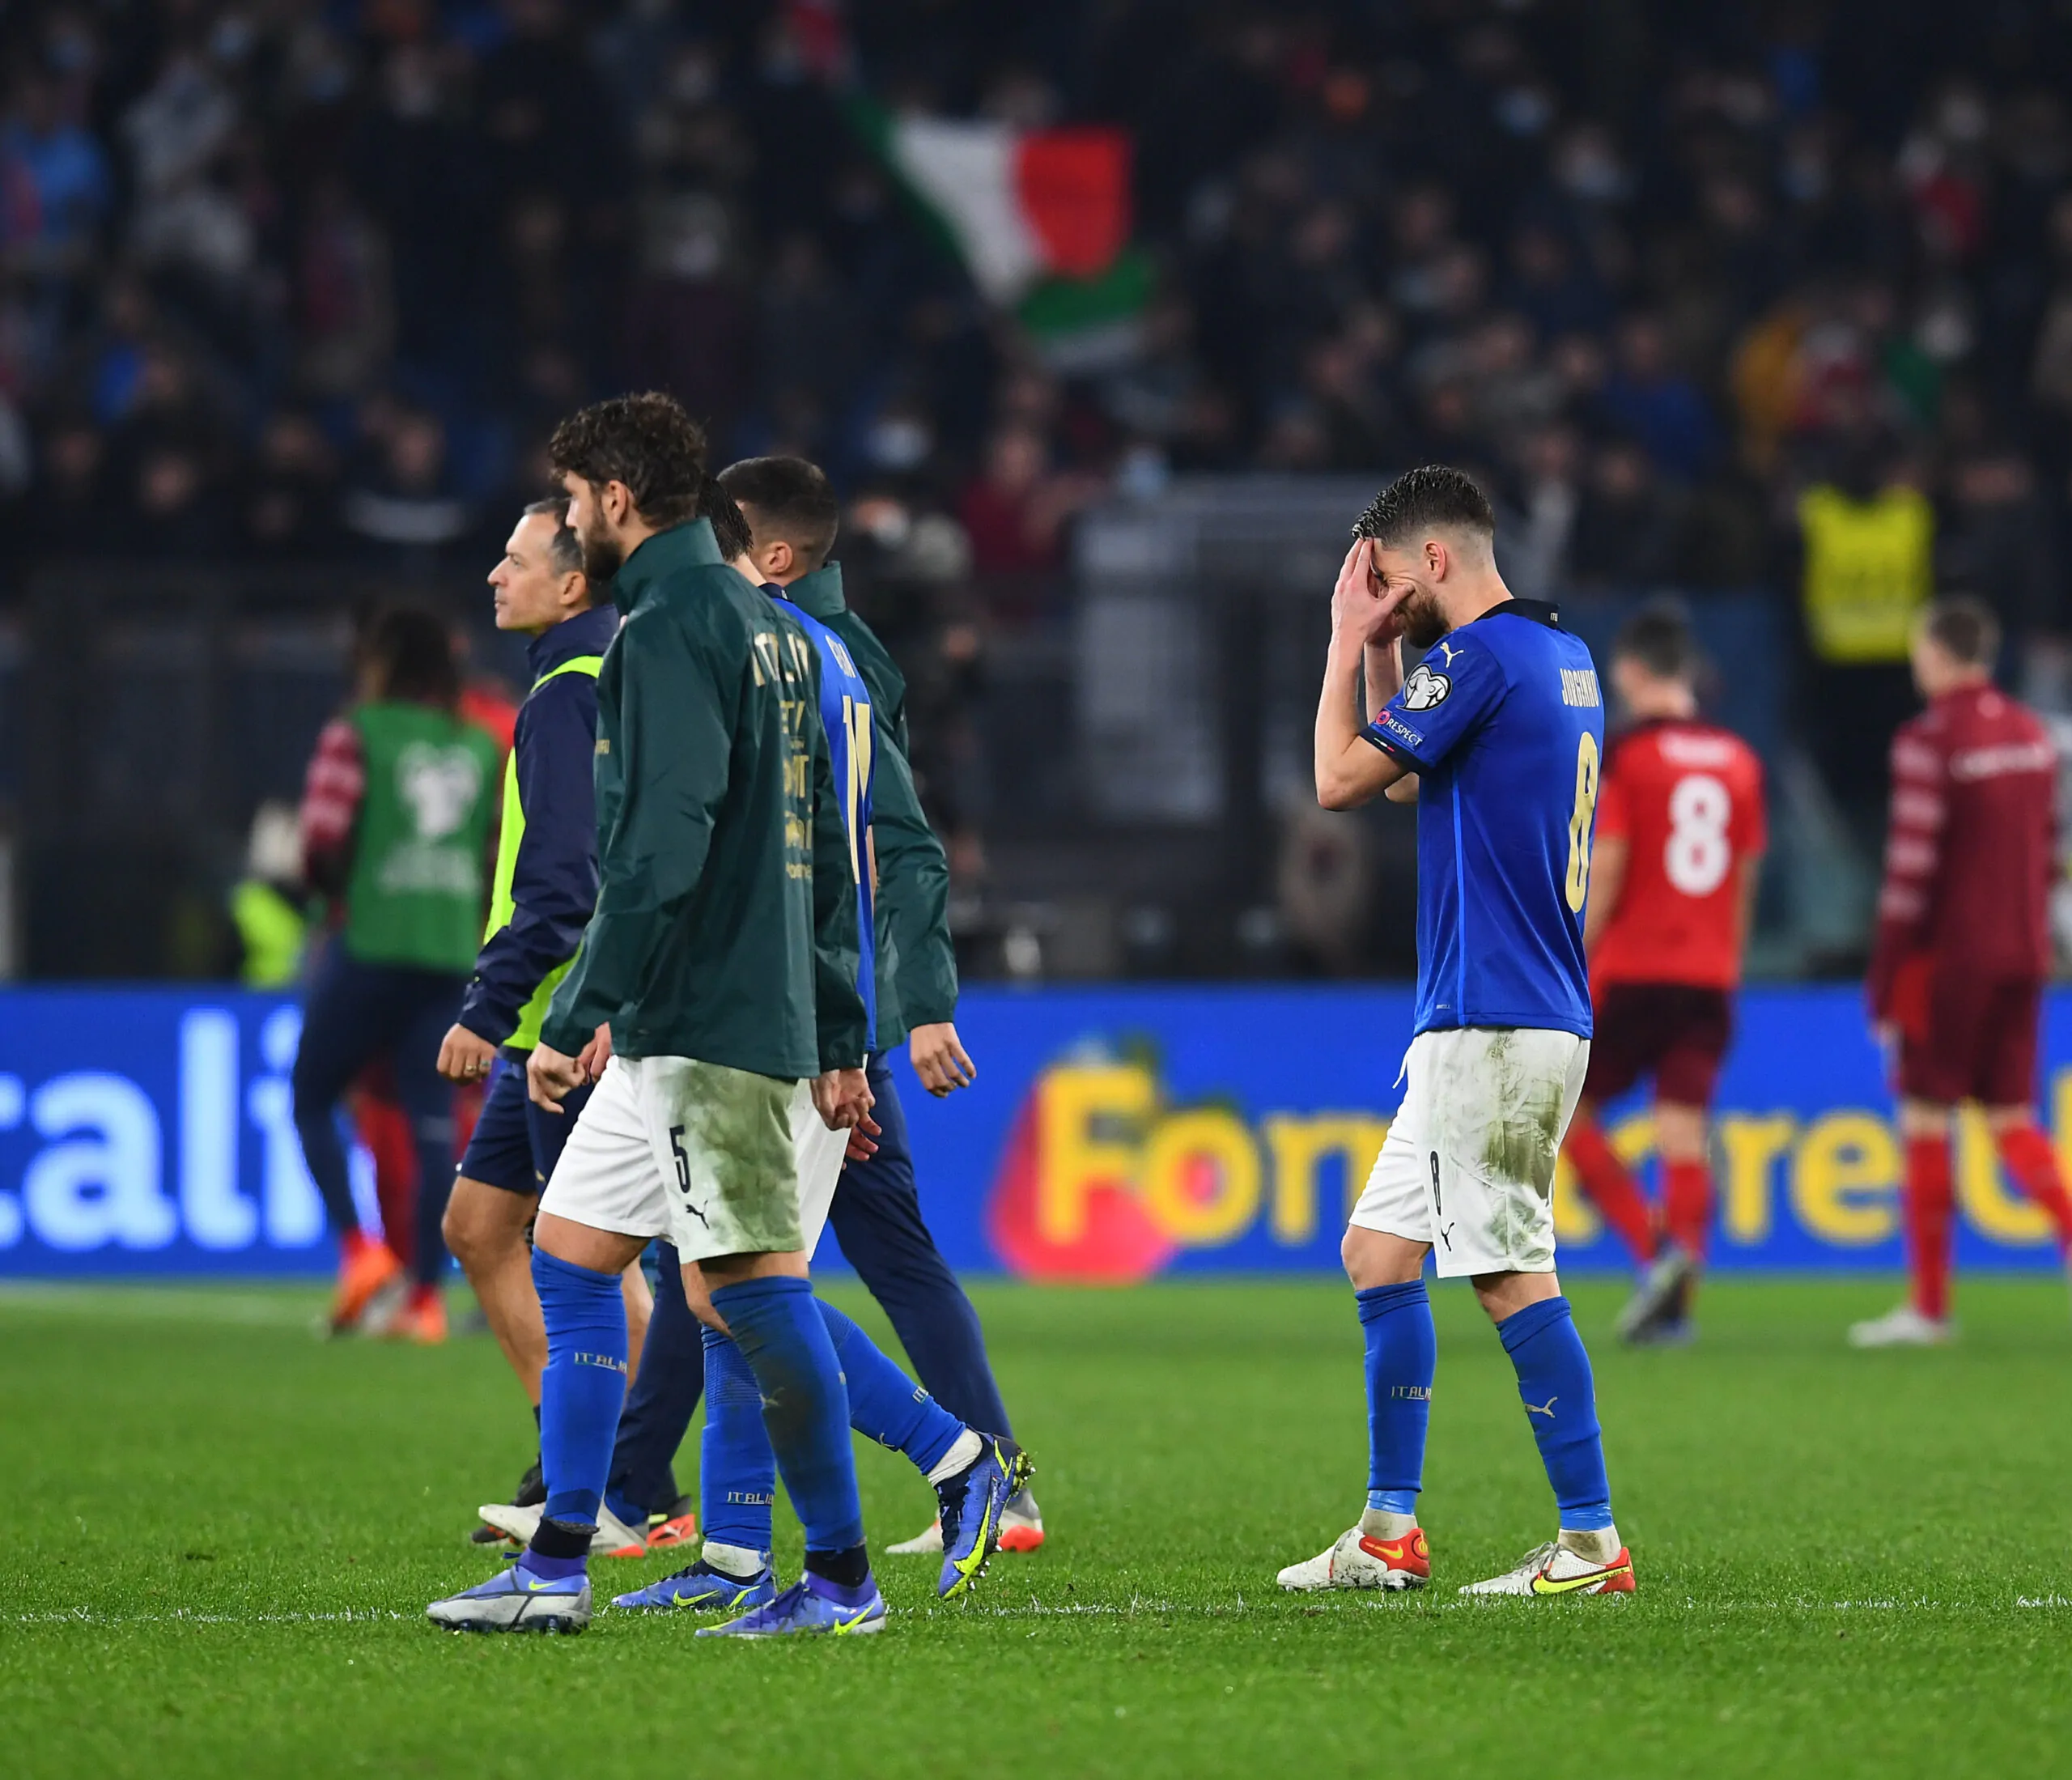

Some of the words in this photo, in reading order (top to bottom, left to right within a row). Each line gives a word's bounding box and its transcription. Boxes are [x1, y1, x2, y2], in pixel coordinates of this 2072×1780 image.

[1386, 718, 1424, 746] RESPECT
[1565, 731, 1599, 913] 8
[1662, 773, 1732, 896] 8
[669, 1124, 691, 1194] 5
